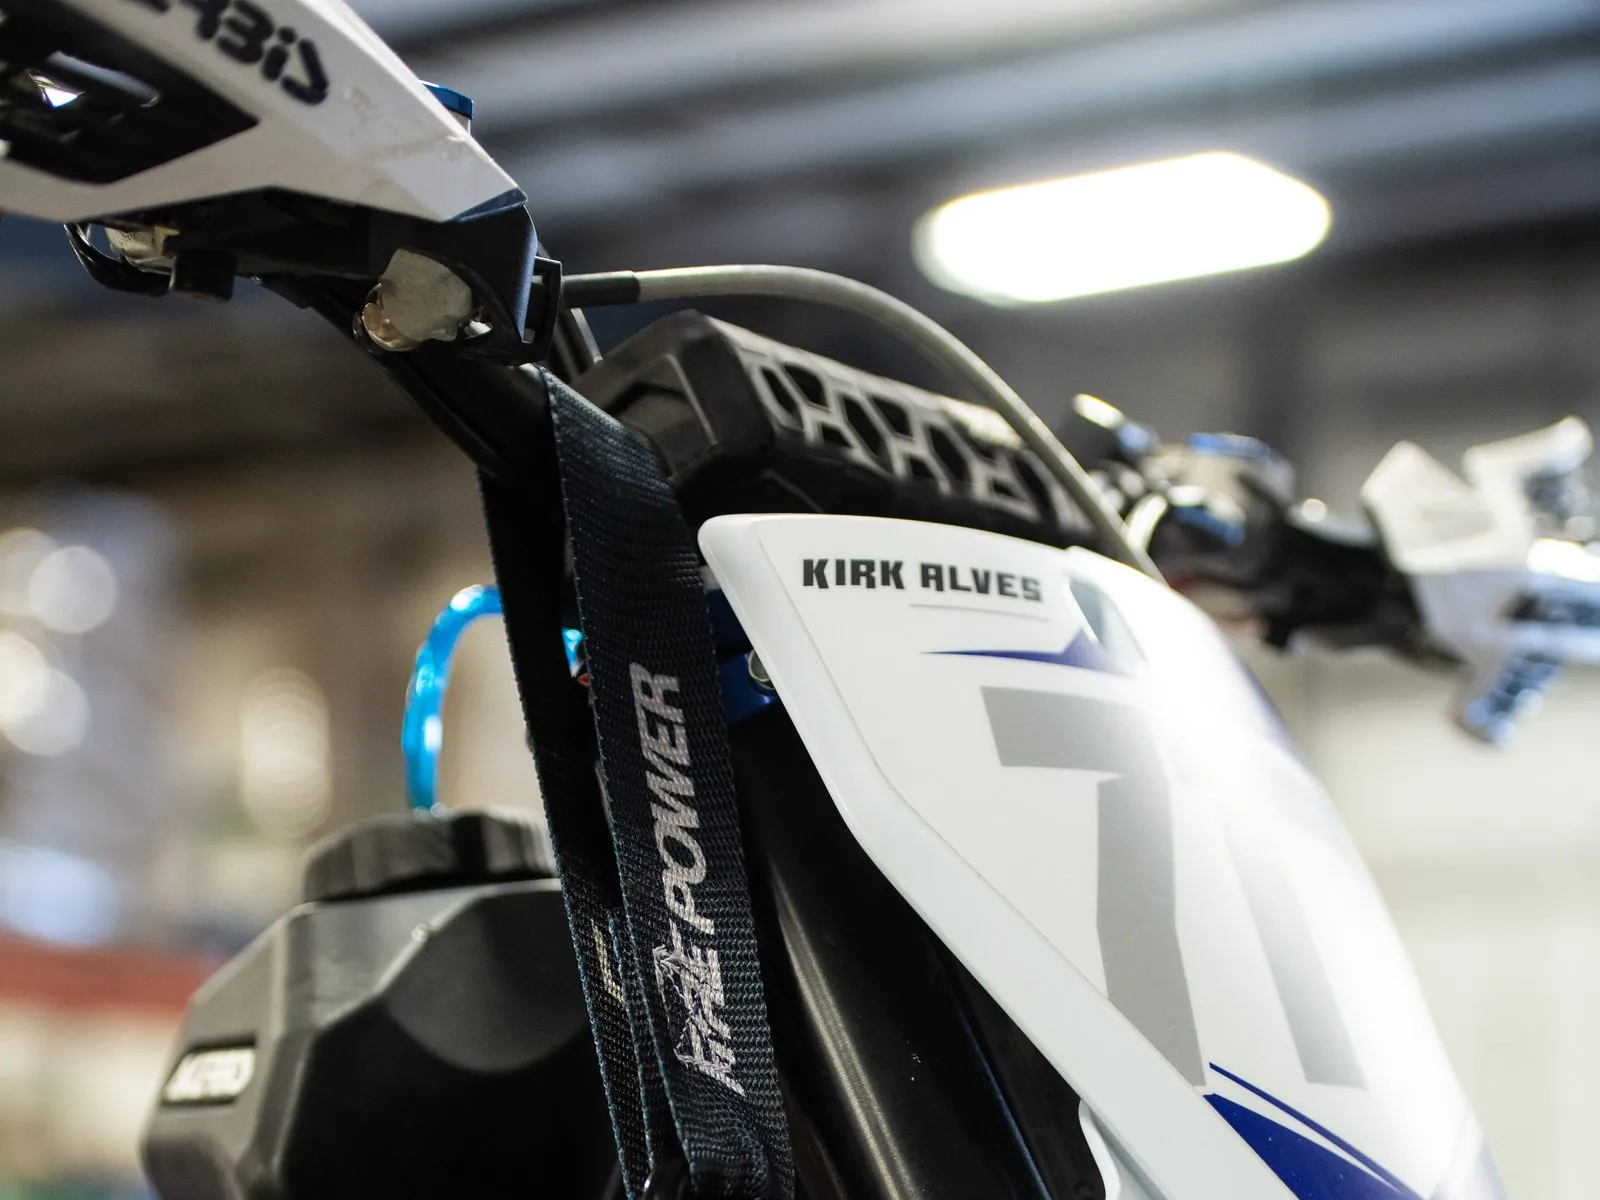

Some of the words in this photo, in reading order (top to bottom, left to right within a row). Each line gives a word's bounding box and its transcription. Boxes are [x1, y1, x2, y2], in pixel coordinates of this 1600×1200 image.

[802, 558, 905, 590] KIRK
[919, 562, 1043, 603] ALVES
[628, 662, 715, 936] POWER
